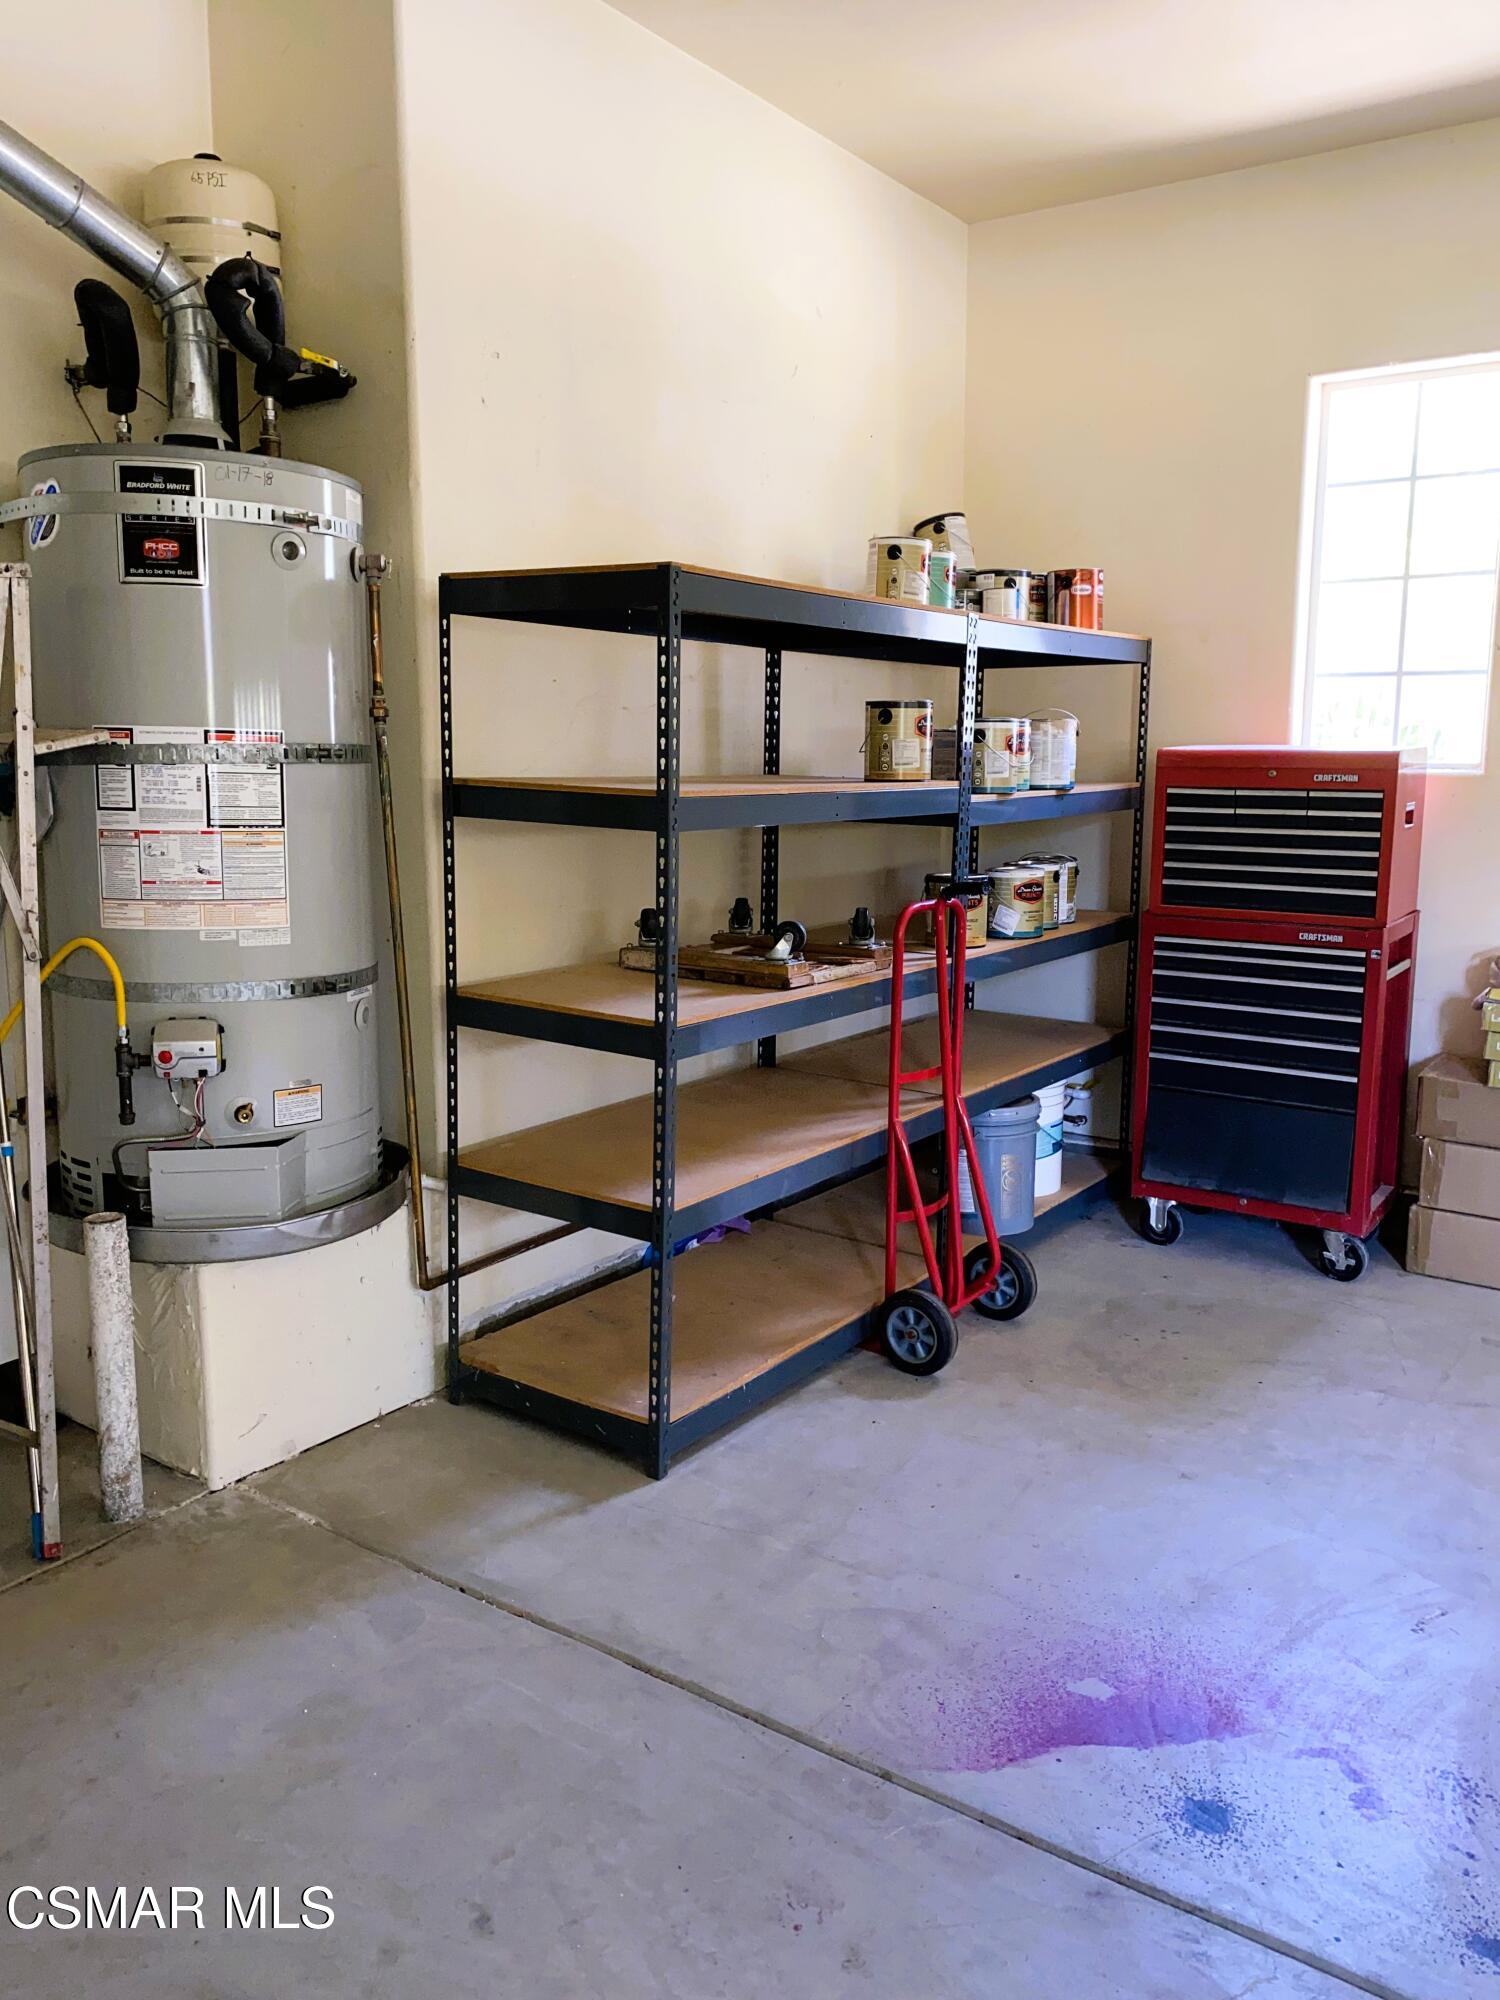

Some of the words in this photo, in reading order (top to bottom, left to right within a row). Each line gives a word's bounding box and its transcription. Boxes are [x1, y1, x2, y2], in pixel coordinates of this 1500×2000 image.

[191, 171, 205, 184] 65
[207, 171, 229, 188] PSI
[126, 481, 166, 489] BRADFORD
[166, 482, 191, 491] WHITE
[127, 515, 193, 523] SERIES
[1313, 773, 1359, 783] CRAFTSMAN
[1298, 932, 1344, 943] CRAFTSMAN
